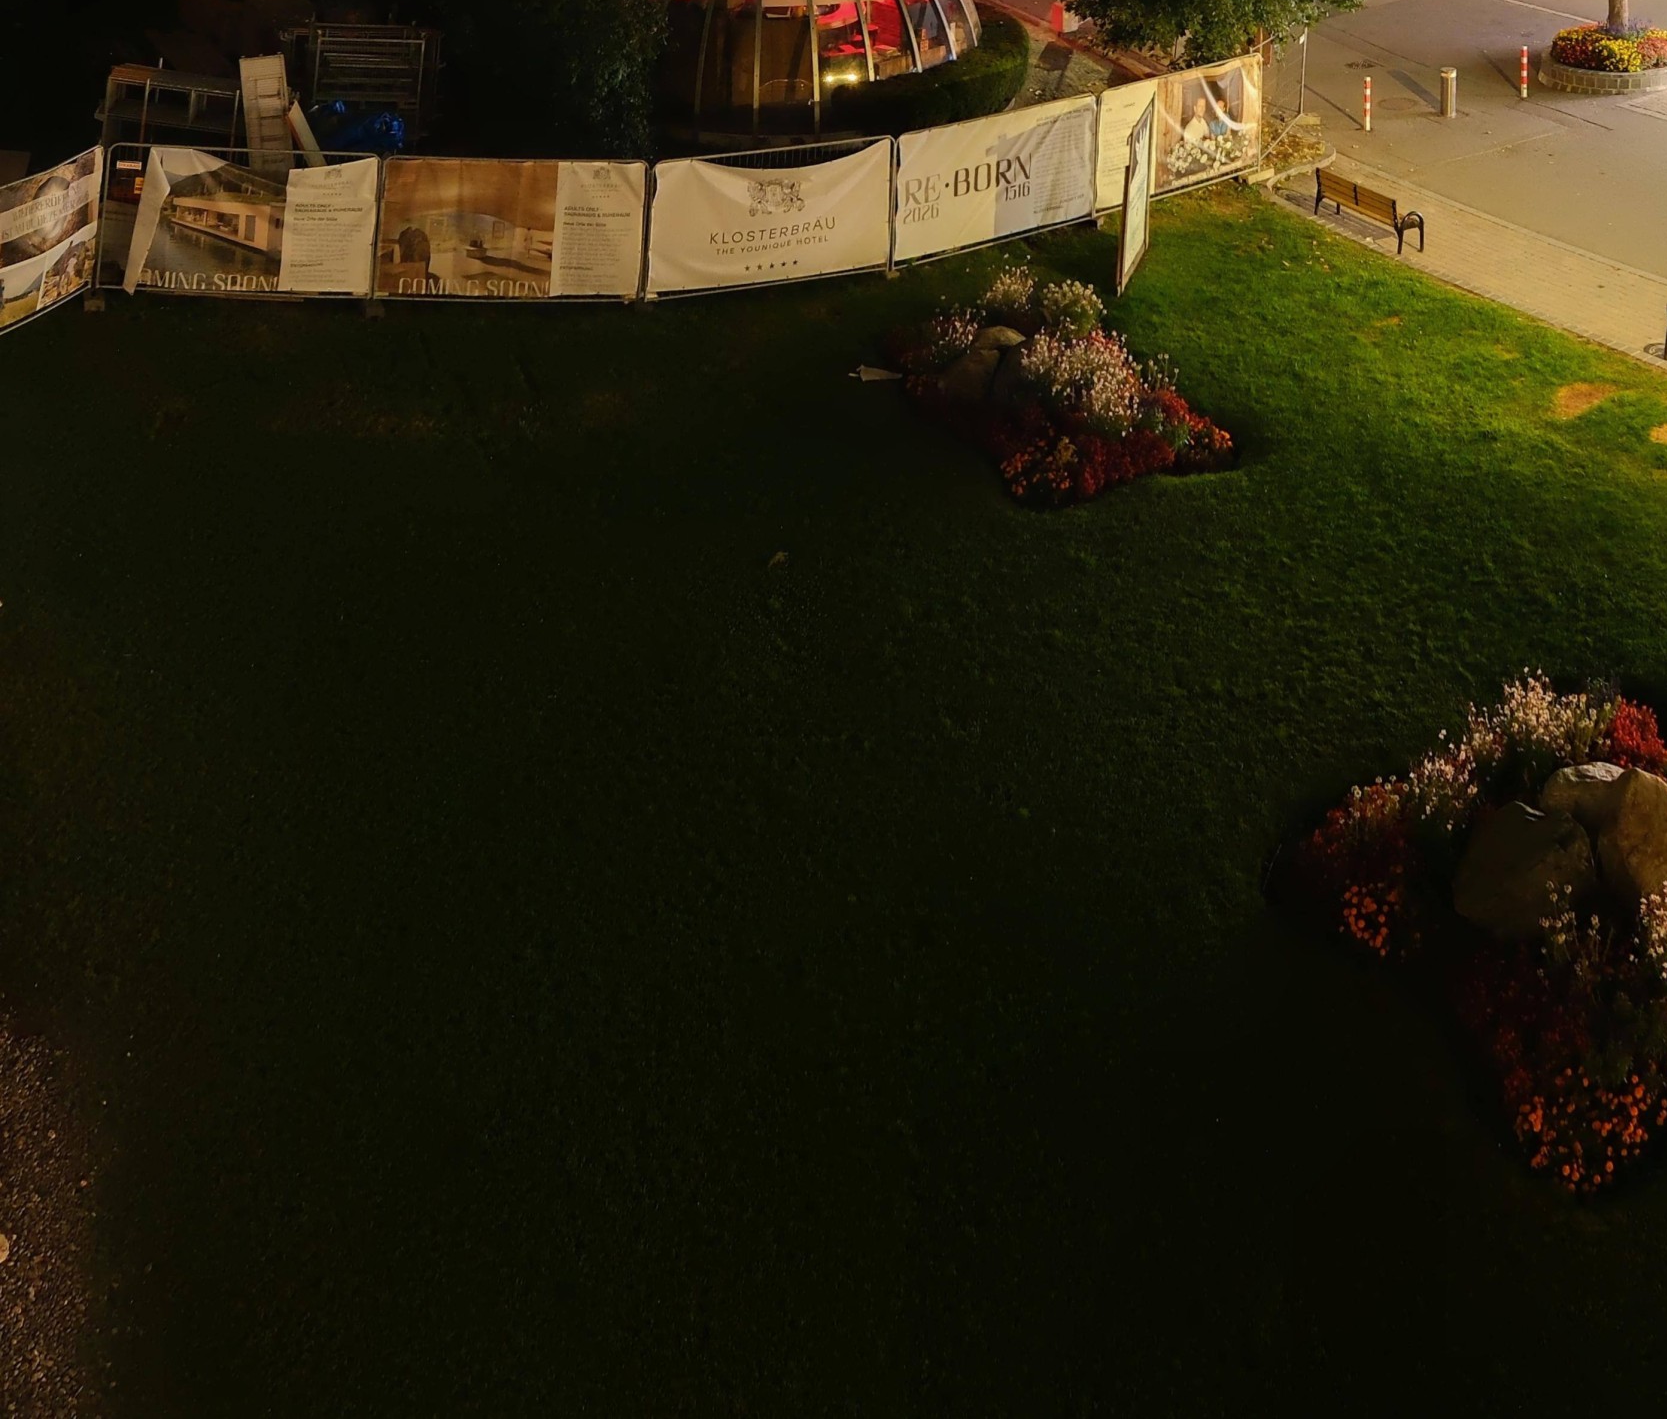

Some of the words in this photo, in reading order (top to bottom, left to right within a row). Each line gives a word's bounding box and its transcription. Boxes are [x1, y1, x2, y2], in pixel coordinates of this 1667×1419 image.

[1004, 181, 1031, 202] 1516
[903, 201, 940, 225] 2026
[709, 215, 837, 245] KLOSTERBRÄU
[716, 247, 735, 256] THE
[741, 238, 792, 254] YOUNIQUE
[796, 234, 829, 246] HOTEL
[138, 268, 207, 291] OMING
